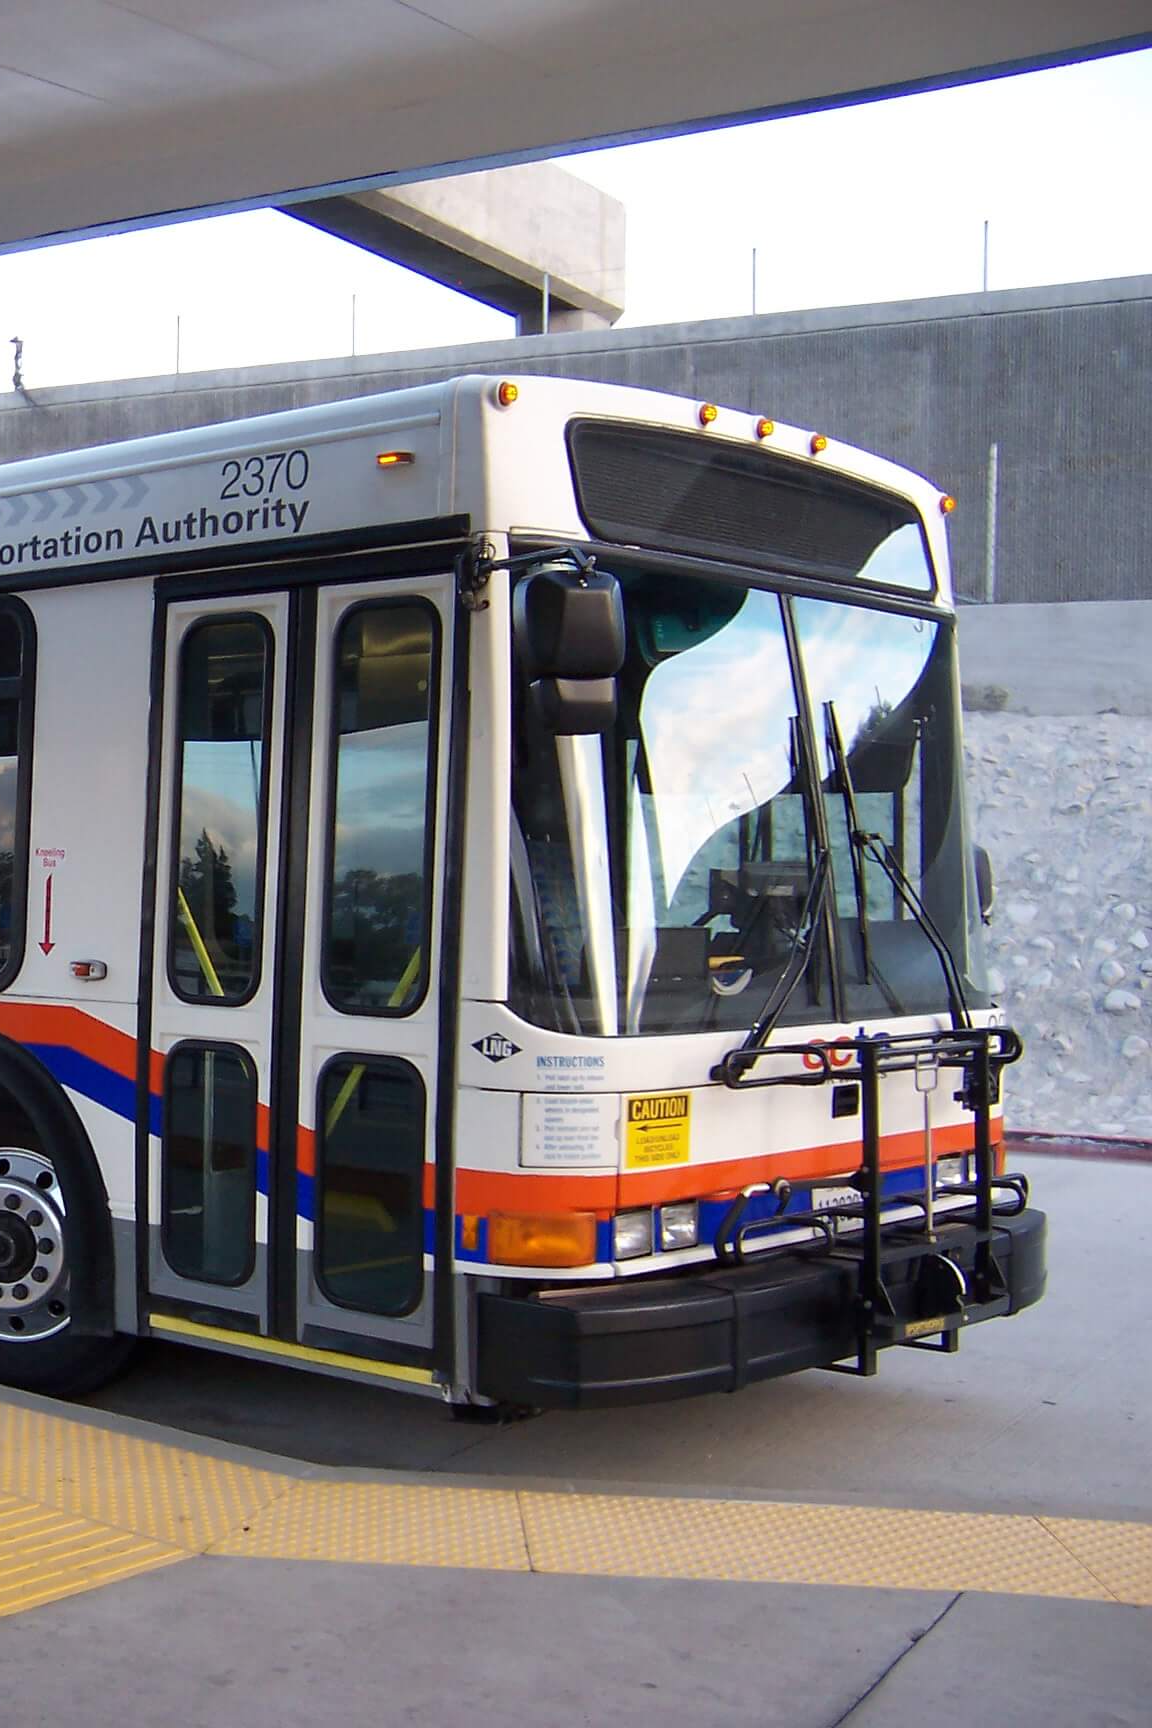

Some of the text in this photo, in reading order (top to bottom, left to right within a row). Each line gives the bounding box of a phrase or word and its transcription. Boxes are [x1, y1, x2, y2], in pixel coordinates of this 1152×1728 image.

[220, 449, 309, 500] 2370
[134, 498, 310, 548] Authority
[482, 1039, 513, 1057] LNG
[536, 1055, 605, 1068] INSTRUCTIONS
[632, 1097, 686, 1120] CAUTION
